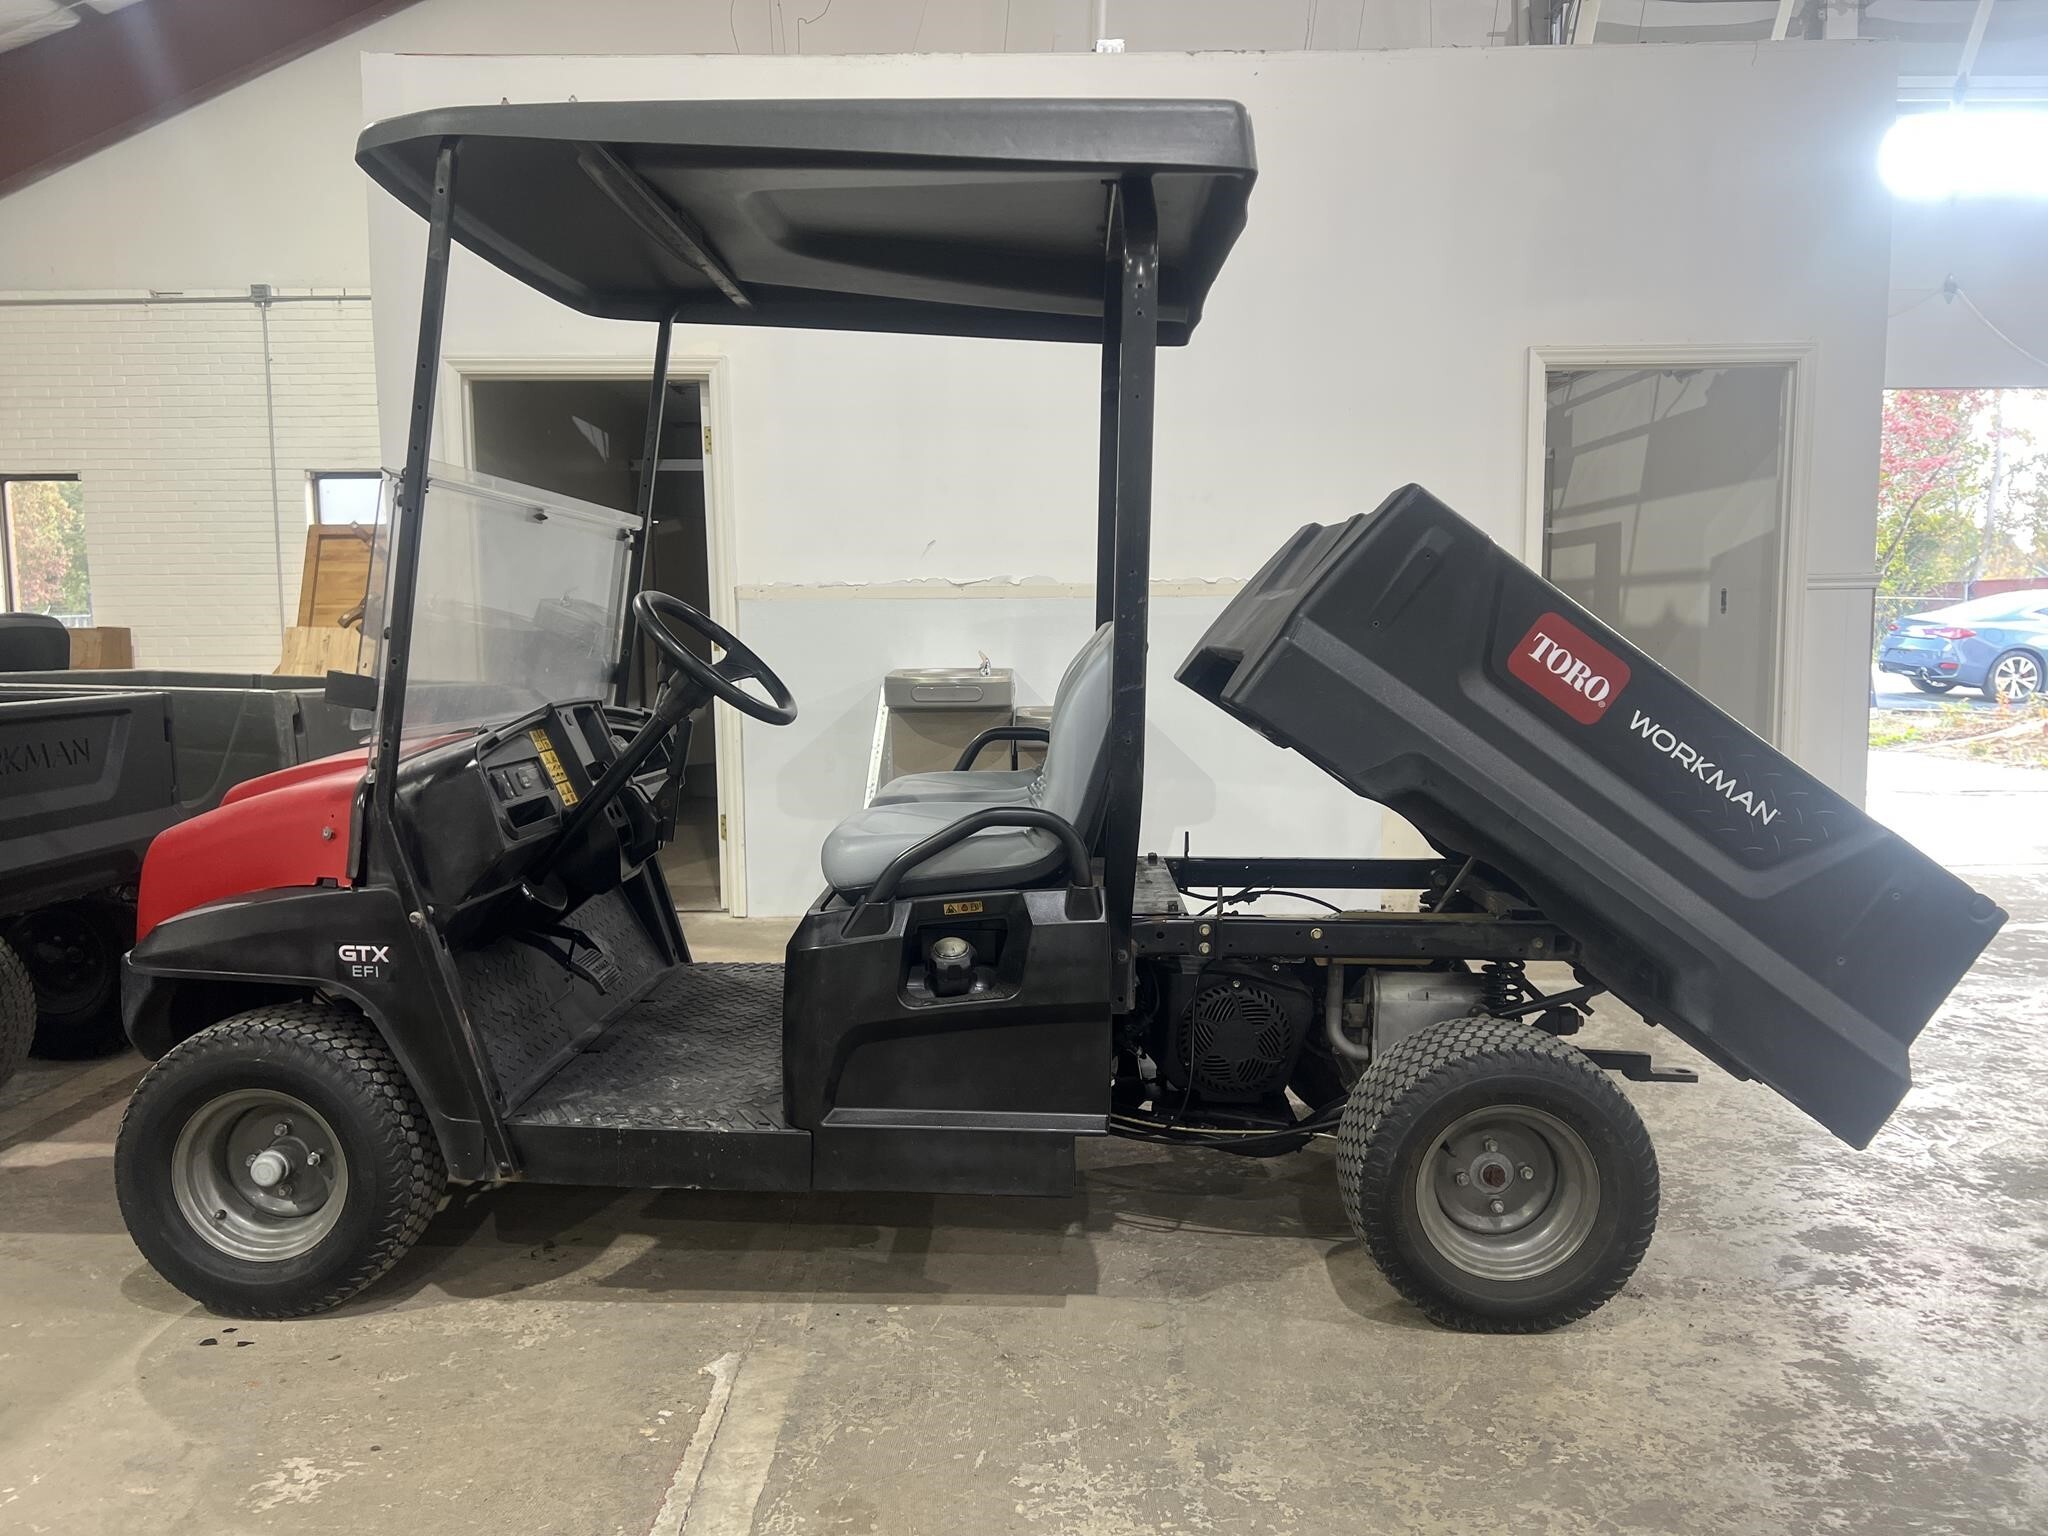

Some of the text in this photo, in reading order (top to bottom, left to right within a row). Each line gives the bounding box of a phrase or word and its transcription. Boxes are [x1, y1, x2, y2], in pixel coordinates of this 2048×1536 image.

[1528, 632, 1610, 702] TORO
[0, 738, 90, 775] KMAN
[1630, 709, 1778, 826] WORKMAN
[338, 945, 389, 963] GTX
[352, 965, 379, 978] EFI
